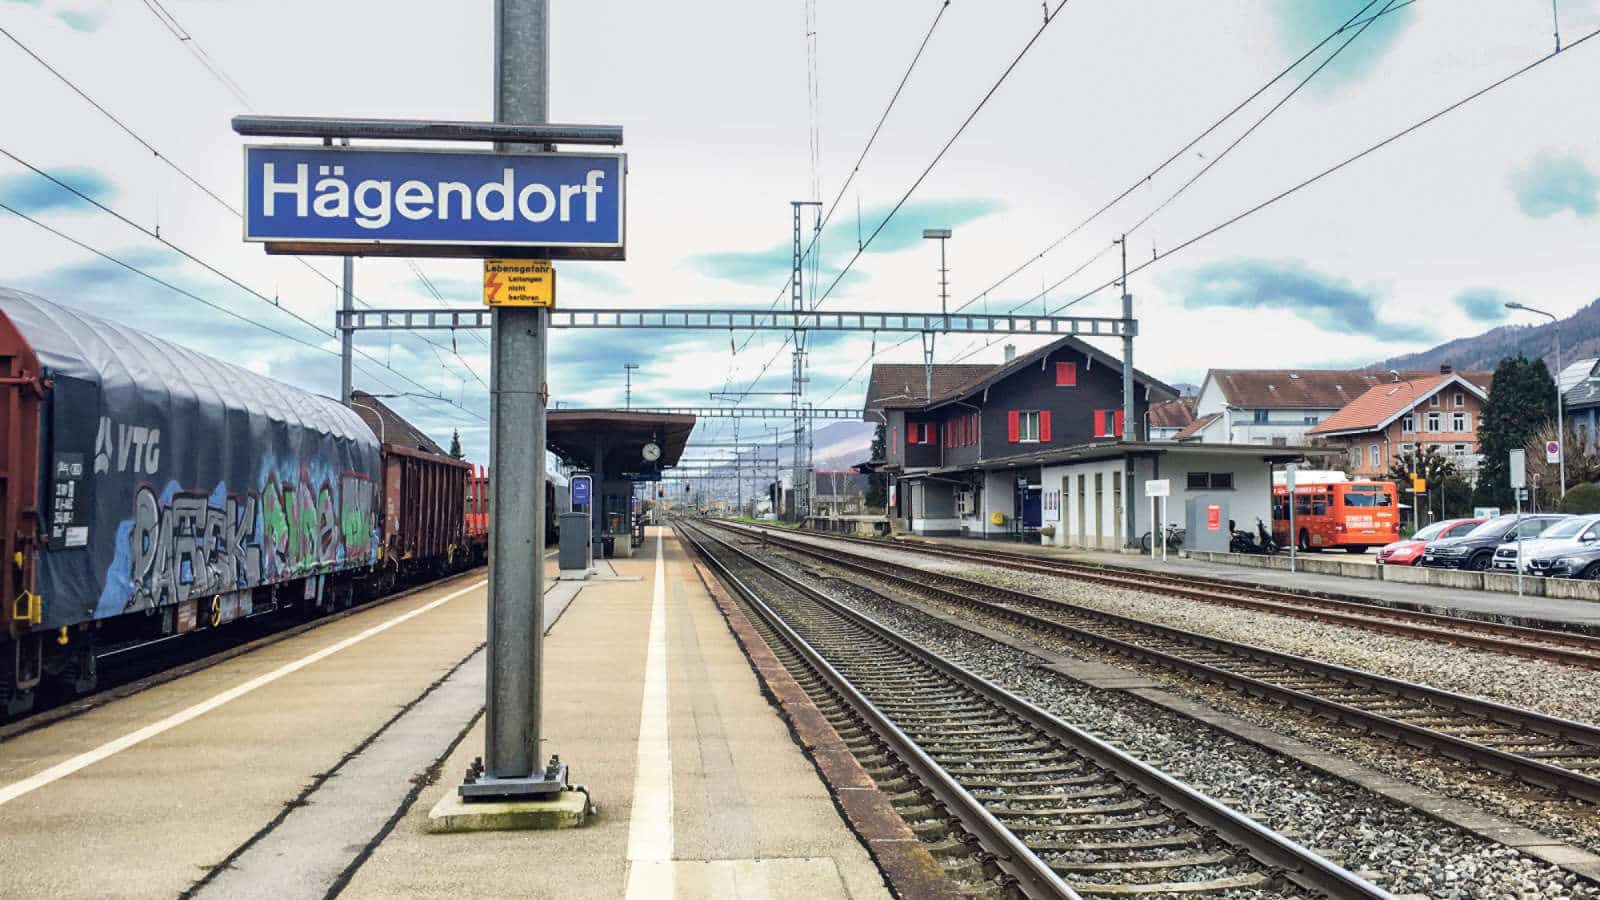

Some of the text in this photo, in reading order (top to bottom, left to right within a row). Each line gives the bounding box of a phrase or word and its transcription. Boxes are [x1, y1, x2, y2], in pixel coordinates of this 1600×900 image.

[263, 162, 605, 230] Hägendorf
[486, 264, 549, 273] Lebensgefahr
[118, 424, 160, 474] VTG
